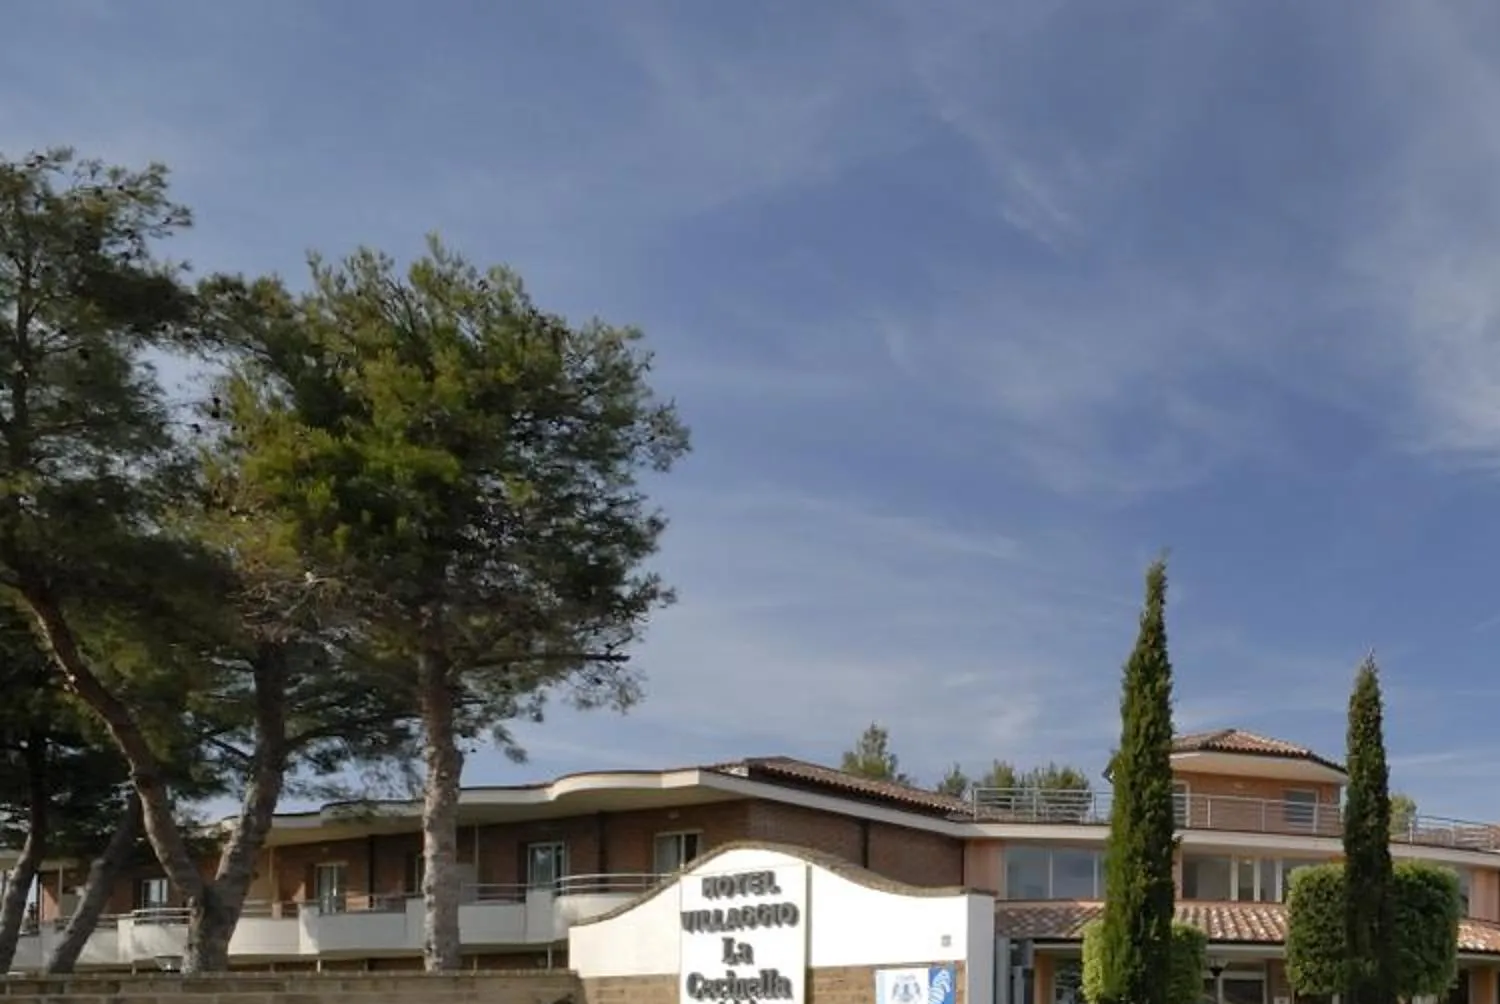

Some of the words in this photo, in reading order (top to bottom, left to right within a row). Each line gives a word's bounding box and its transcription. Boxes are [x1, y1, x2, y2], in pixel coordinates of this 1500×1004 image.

[702, 871, 781, 900] HOTEL
[681, 902, 799, 934] VILLAGGIO
[721, 937, 754, 966] La
